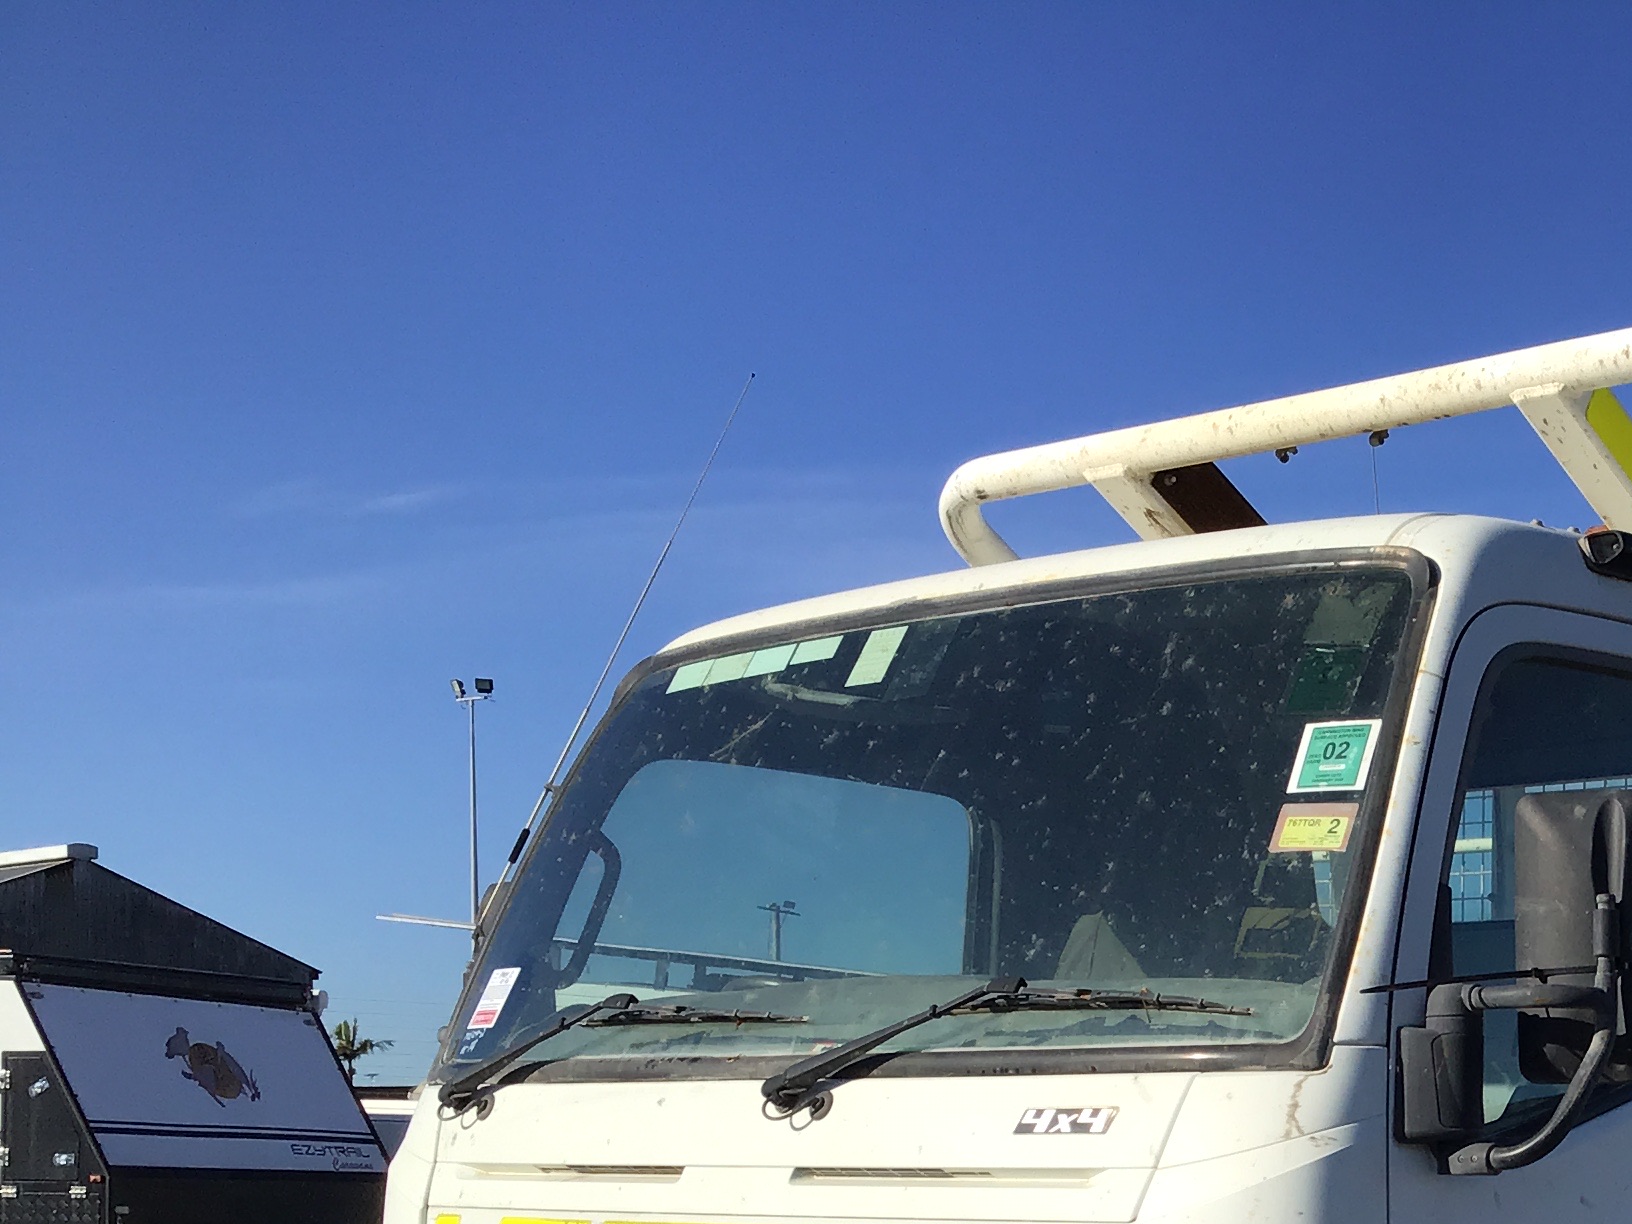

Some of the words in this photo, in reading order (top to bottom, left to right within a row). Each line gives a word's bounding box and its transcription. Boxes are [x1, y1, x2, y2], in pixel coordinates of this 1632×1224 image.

[1323, 741, 1351, 760] 02
[1327, 818, 1341, 834] 2
[1020, 1107, 1114, 1135] 4x4
